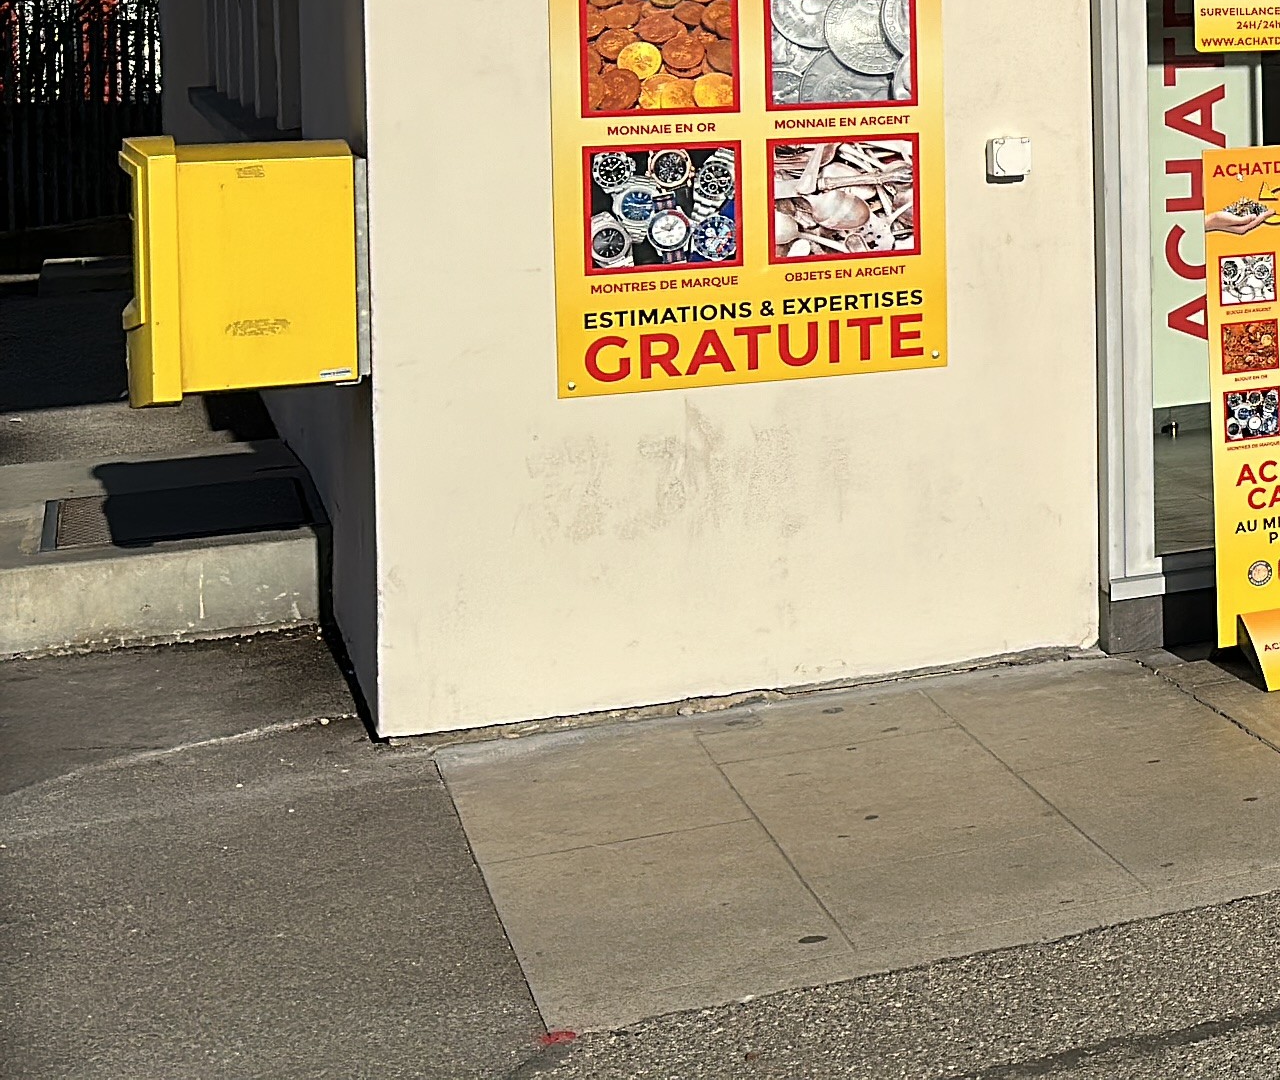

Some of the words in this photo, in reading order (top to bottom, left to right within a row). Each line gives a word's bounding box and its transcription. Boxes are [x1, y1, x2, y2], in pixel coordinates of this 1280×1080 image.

[1201, 7, 1280, 16] SURVEILLANCE
[1237, 20, 1280, 30] 24H/24h
[607, 124, 672, 136] MONNAIE
[675, 123, 694, 134] EN
[696, 122, 716, 133] OR
[775, 118, 836, 129] MONNAIE
[840, 117, 856, 126] EN
[860, 115, 910, 126] ARGENT
[785, 270, 831, 283] OBJETS
[835, 268, 852, 279] EN
[855, 265, 905, 277] ARGENT
[591, 281, 656, 294] MONTRES
[660, 280, 677, 289] DE
[682, 276, 738, 288] MARQUE
[584, 301, 751, 330] ESTIMATIONS
[761, 299, 776, 316] &
[782, 289, 923, 315] EXPERTISES
[585, 313, 924, 382] GRATUITE
[1235, 517, 1258, 535] AU
